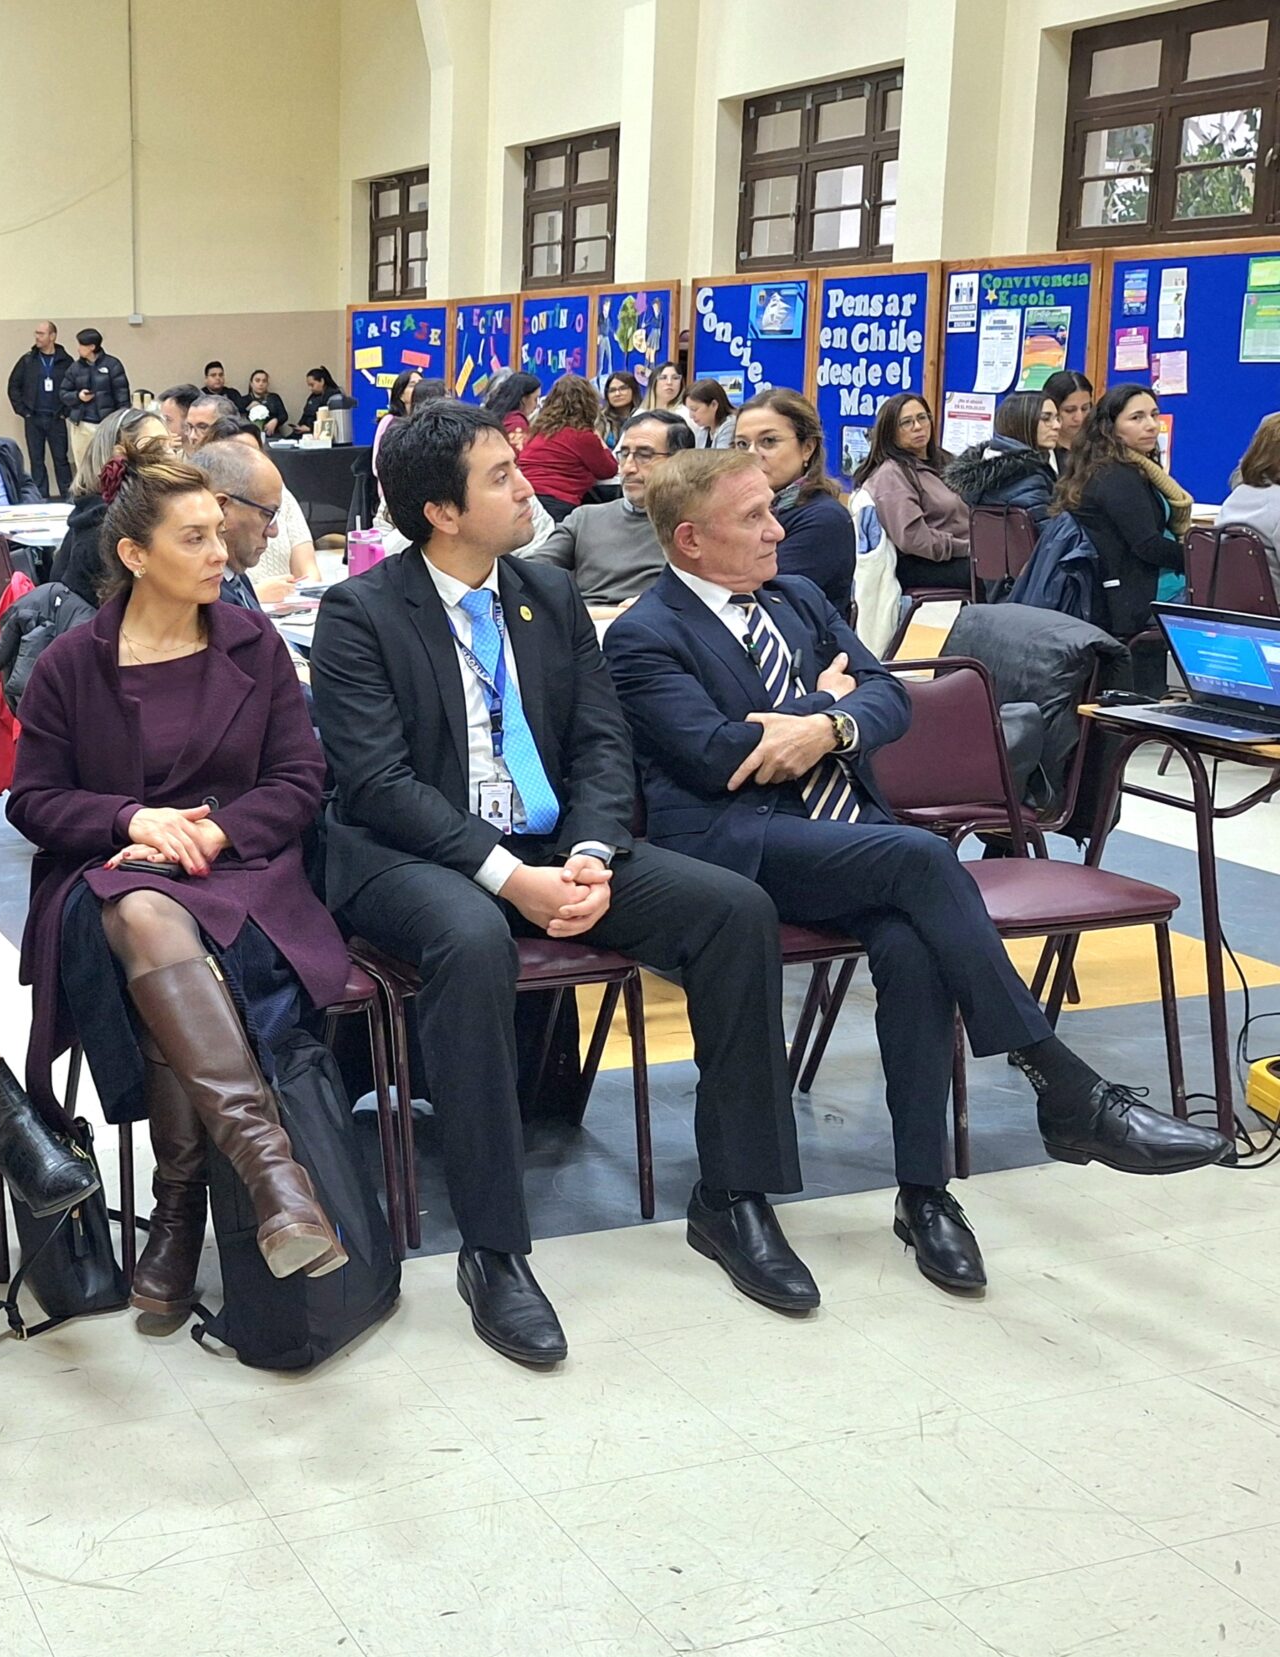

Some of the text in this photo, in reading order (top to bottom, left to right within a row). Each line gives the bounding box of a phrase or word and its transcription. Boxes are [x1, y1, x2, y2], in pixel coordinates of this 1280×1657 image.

[981, 273, 1089, 289] Convivencia
[827, 289, 917, 318] Pensar
[998, 289, 1055, 306] Escola
[355, 314, 441, 346] PAISAJE
[456, 308, 510, 335] AECTIVO
[521, 303, 584, 334] CONTINO
[819, 319, 922, 353] en Chile
[521, 343, 582, 375] EMOIONES
[817, 356, 911, 389] desde el
